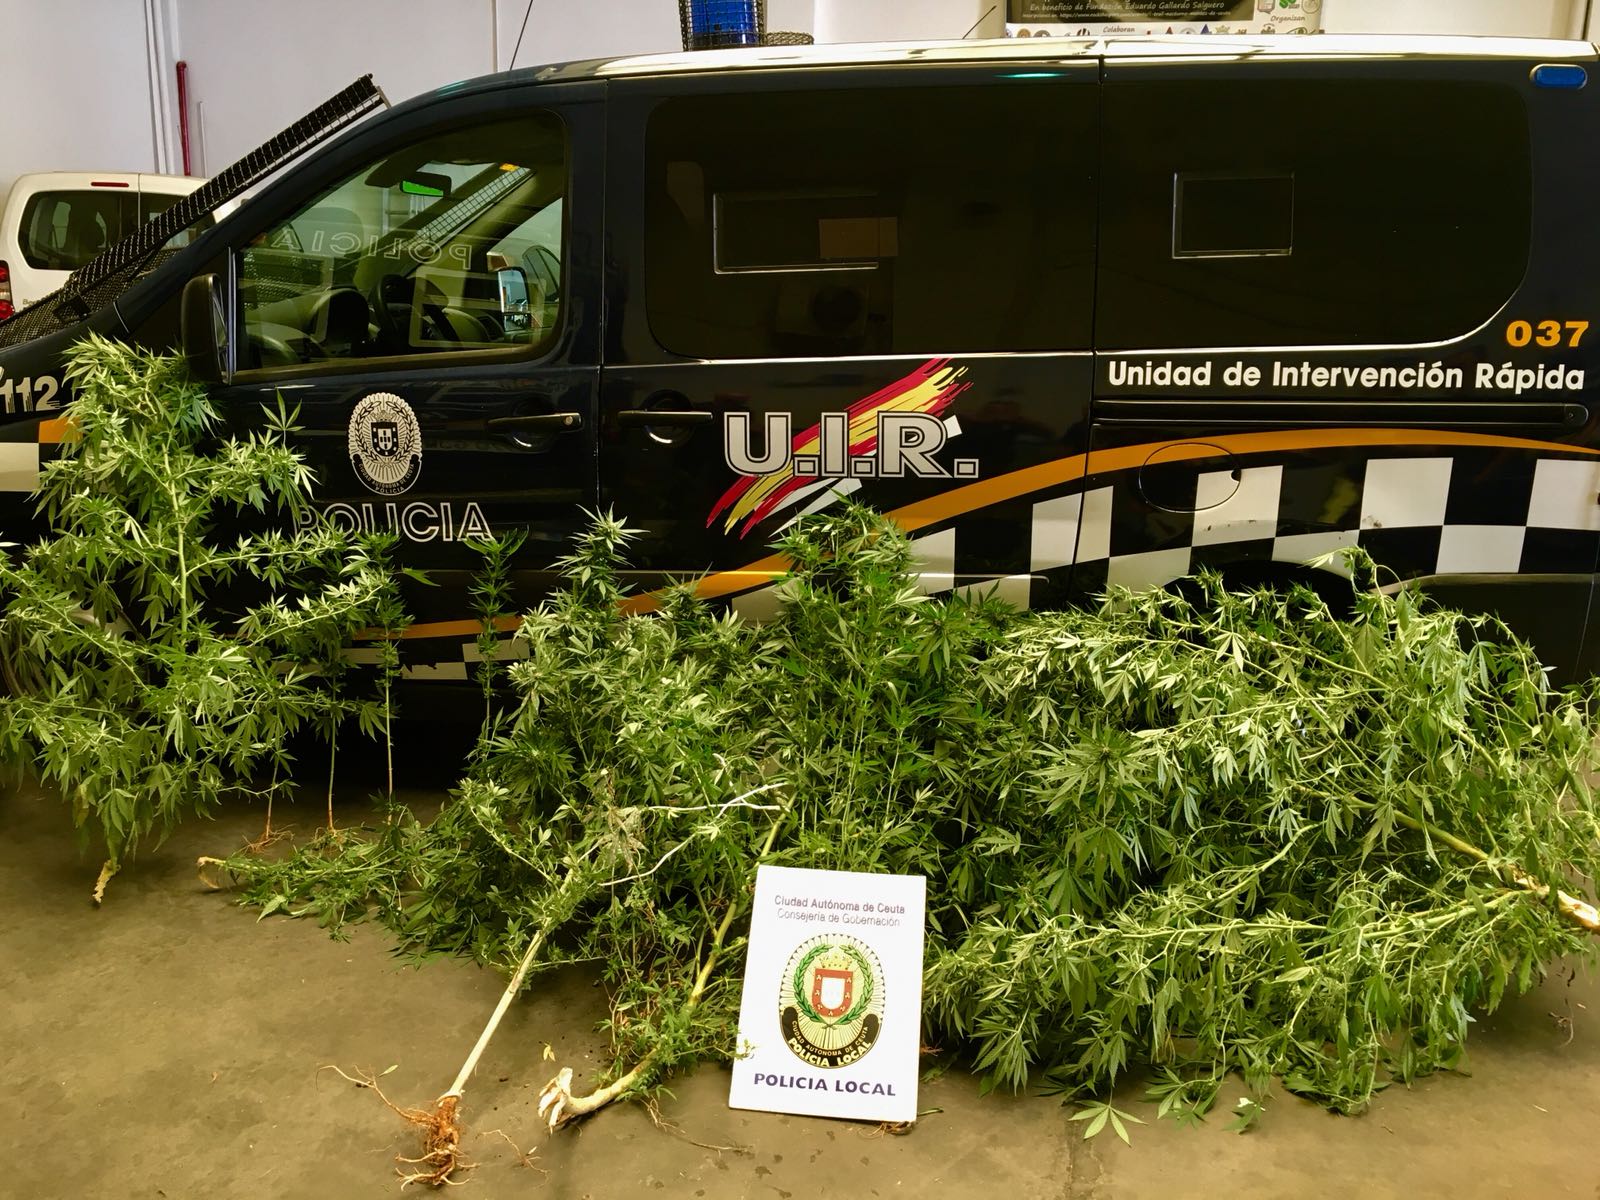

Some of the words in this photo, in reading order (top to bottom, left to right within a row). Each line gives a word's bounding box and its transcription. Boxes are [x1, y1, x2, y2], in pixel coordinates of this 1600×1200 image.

[1042, 3, 1073, 11] beneficio
[1125, 2, 1157, 10] Eduardo
[1159, 1, 1191, 9] Gallardo
[1192, 1, 1225, 10] Salguero
[1103, 25, 1136, 33] Colaboran
[1271, 15, 1306, 23] Organizan
[1506, 320, 1590, 347] 037
[1108, 361, 1212, 386] Unidad
[1223, 361, 1261, 386] de
[1272, 361, 1463, 389] Intervención
[1475, 362, 1585, 395] Rápida
[0, 376, 60, 414] 112
[723, 411, 979, 479] U.I.R.
[774, 895, 809, 908] Ciudad
[810, 898, 860, 912] Autónoma
[862, 902, 875, 912] de
[877, 903, 905, 915] Ceuta
[828, 912, 840, 922] de
[791, 1021, 805, 1043] CIUDAD
[805, 1044, 842, 1056] AUTONOMA
[855, 1026, 868, 1046] CEUTA
[788, 1037, 831, 1067] POLICIA
[836, 1041, 872, 1066] LOCAL
[753, 1073, 829, 1091] POLICIA
[835, 1080, 896, 1097] LOCAL
